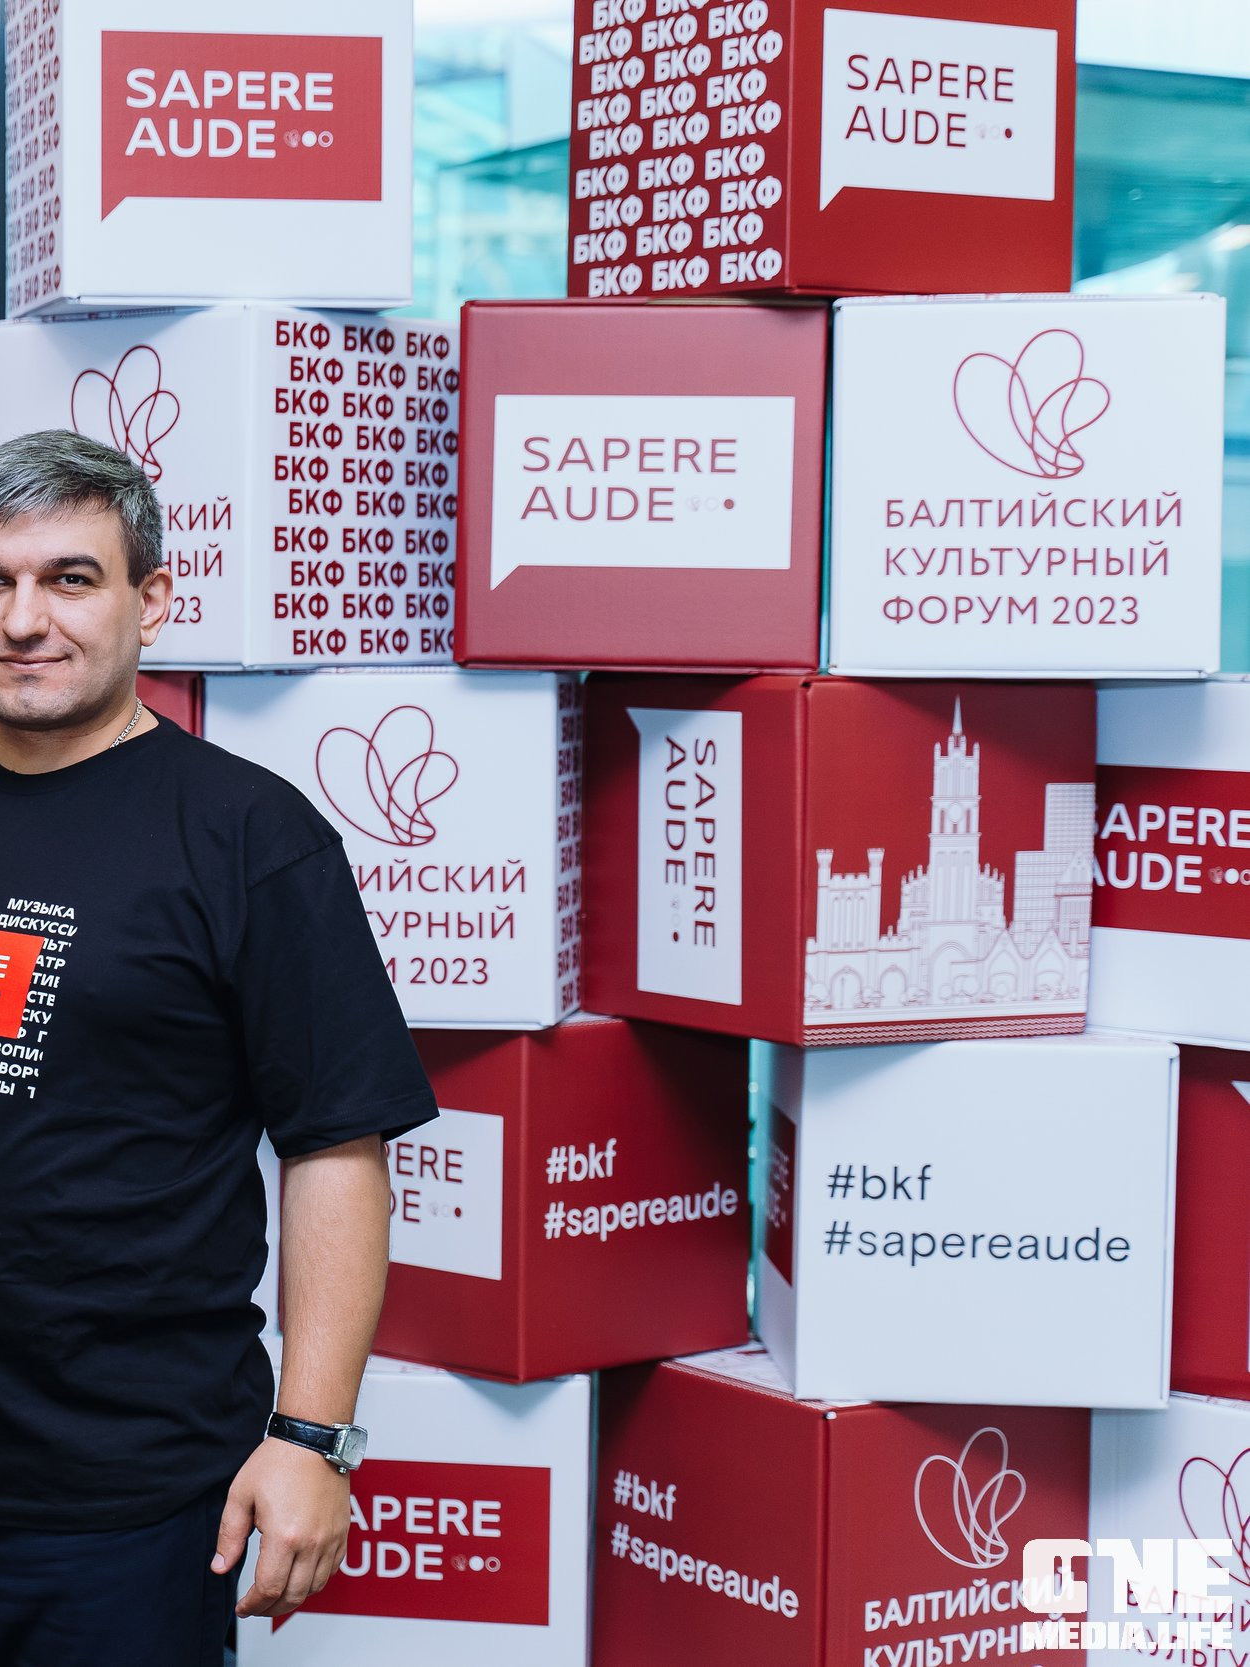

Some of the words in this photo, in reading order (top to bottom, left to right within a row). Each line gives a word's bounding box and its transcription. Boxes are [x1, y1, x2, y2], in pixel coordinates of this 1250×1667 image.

[579, 27, 632, 65] БКФ
[642, 13, 698, 52] БКФ
[708, 0, 768, 39] БКФ
[591, 56, 645, 94] БКФ
[654, 44, 711, 82] БКФ
[722, 30, 782, 69] БКФ
[848, 55, 1013, 102] SAPERE
[127, 68, 333, 111] SAPERE
[577, 93, 631, 130] БКФ
[640, 81, 696, 119] БКФ
[707, 69, 767, 108] БКФ
[125, 118, 275, 158] AUDE
[846, 106, 966, 147] AUDE
[277, 321, 330, 350] БКФ
[344, 325, 394, 355] БКФ
[407, 332, 449, 360] БКФ
[291, 356, 343, 385] БКФ
[358, 361, 406, 389] БКФ
[418, 367, 459, 394] БКФ
[276, 388, 329, 416] БКФ
[344, 393, 393, 420] БКФ
[406, 397, 448, 424] БКФ
[523, 437, 736, 473] SAPERE
[521, 487, 674, 521] AUDE
[887, 492, 1181, 527] БАЛТИЙСКИЙ
[886, 541, 1167, 575] КУЛЬТУРНЫЙ
[164, 596, 202, 623] 23
[883, 596, 1036, 624] ФОРУМ
[1053, 596, 1138, 624] 2023
[665, 735, 686, 884] AUDE
[1095, 803, 1250, 848] APERE
[695, 739, 716, 946] SAPERE
[350, 858, 526, 893] ИЙСКИЙ
[7, 898, 74, 919] МУЗЫКА
[367, 905, 516, 939] УРНЫЙ
[410, 958, 489, 984] 2023
[387, 1143, 463, 1183] ERE
[546, 1138, 616, 1184] #bkf
[828, 1165, 931, 1200] #bkf
[544, 1184, 737, 1242] #sapereaude
[825, 1221, 1130, 1266] #sapereaude
[614, 1471, 676, 1521] #bkf
[612, 1523, 799, 1618] #sapereaude
